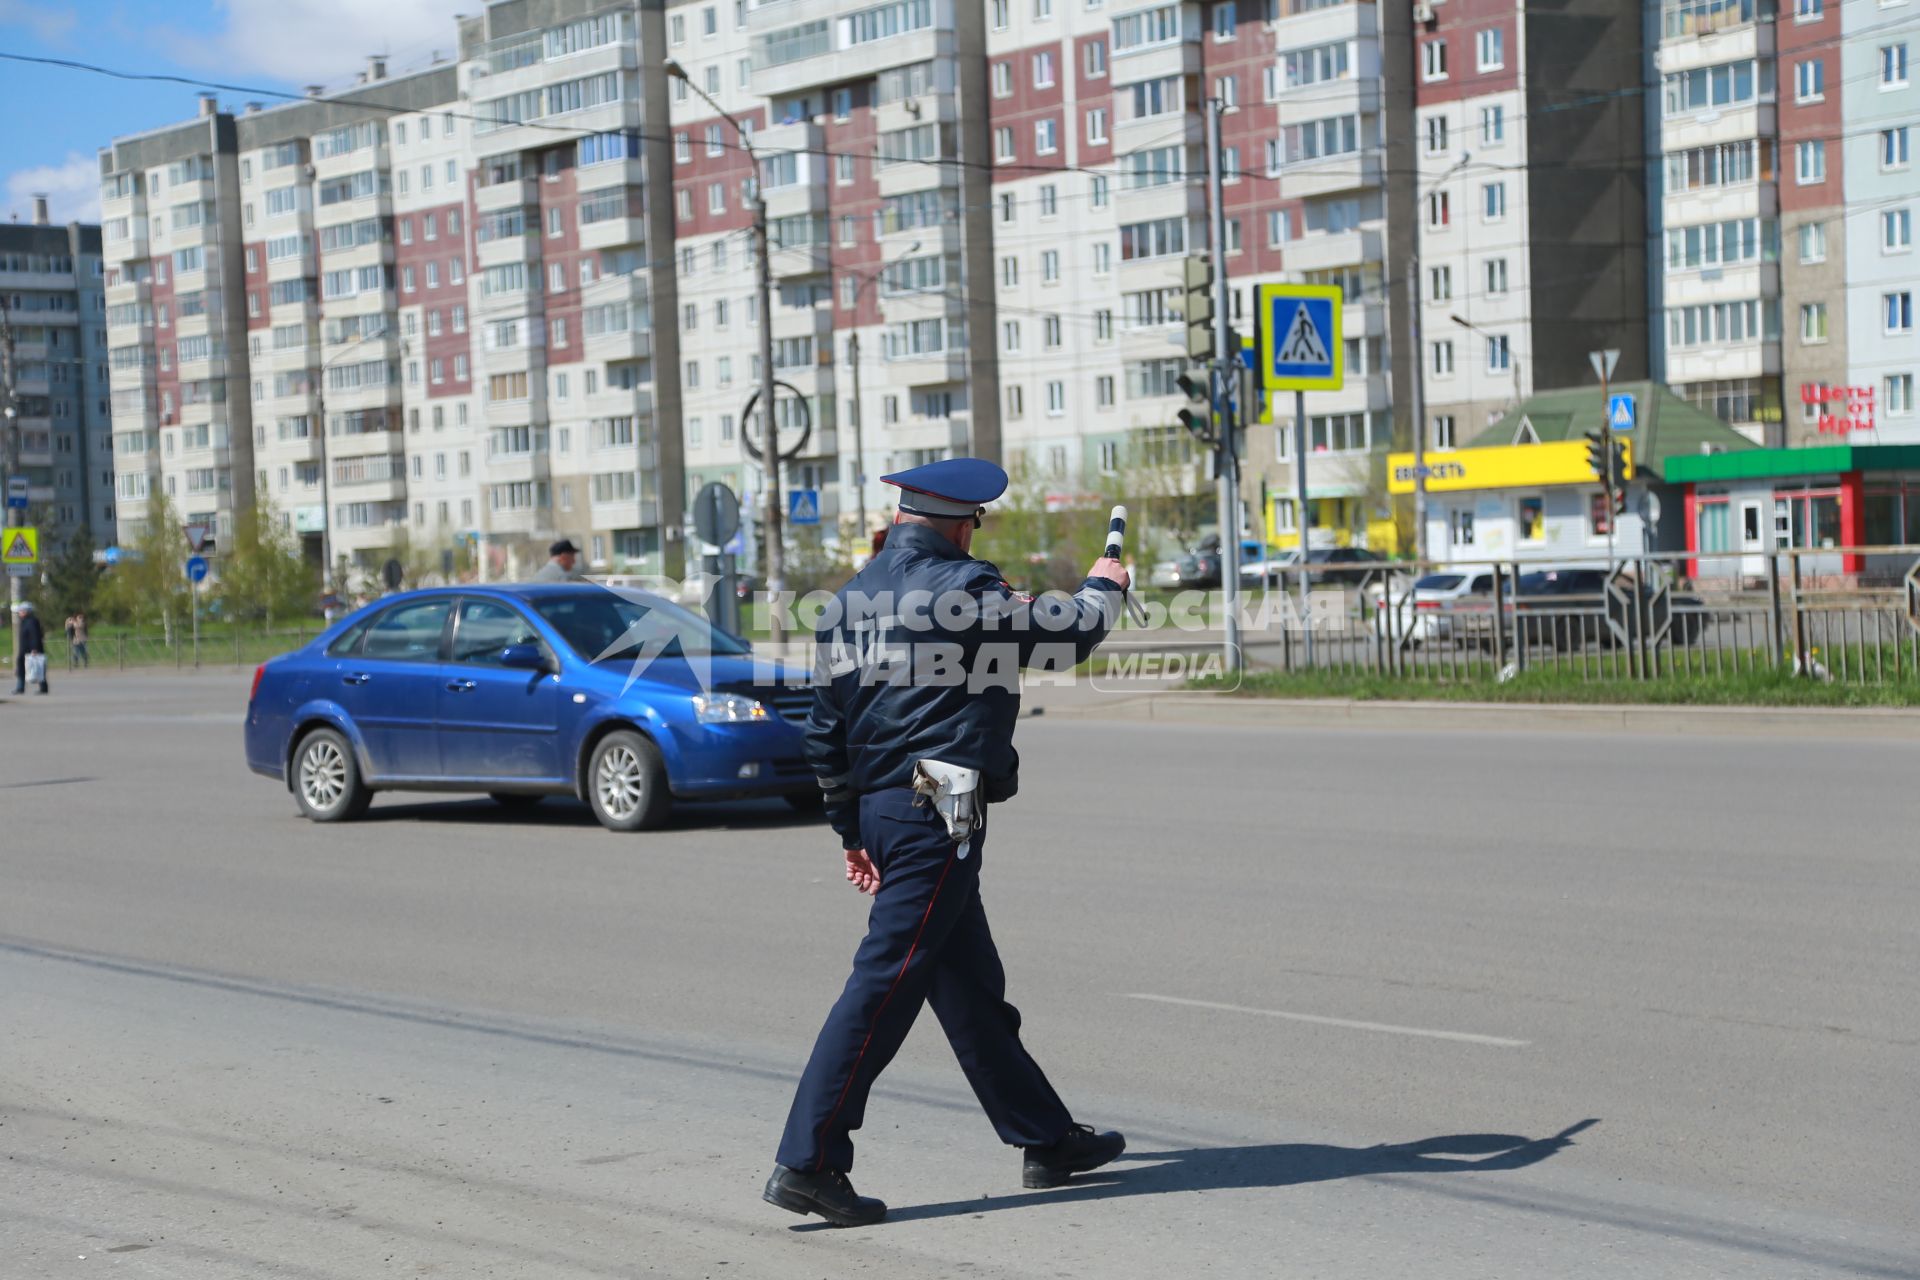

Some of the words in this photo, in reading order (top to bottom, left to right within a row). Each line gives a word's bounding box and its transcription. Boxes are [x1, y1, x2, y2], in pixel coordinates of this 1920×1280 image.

[1800, 384, 1874, 404] Цветы
[1847, 401, 1874, 414] от
[1818, 415, 1874, 436] Иры
[1395, 462, 1466, 481] ЕВСЕТЬ
[829, 615, 907, 675] ДПС
